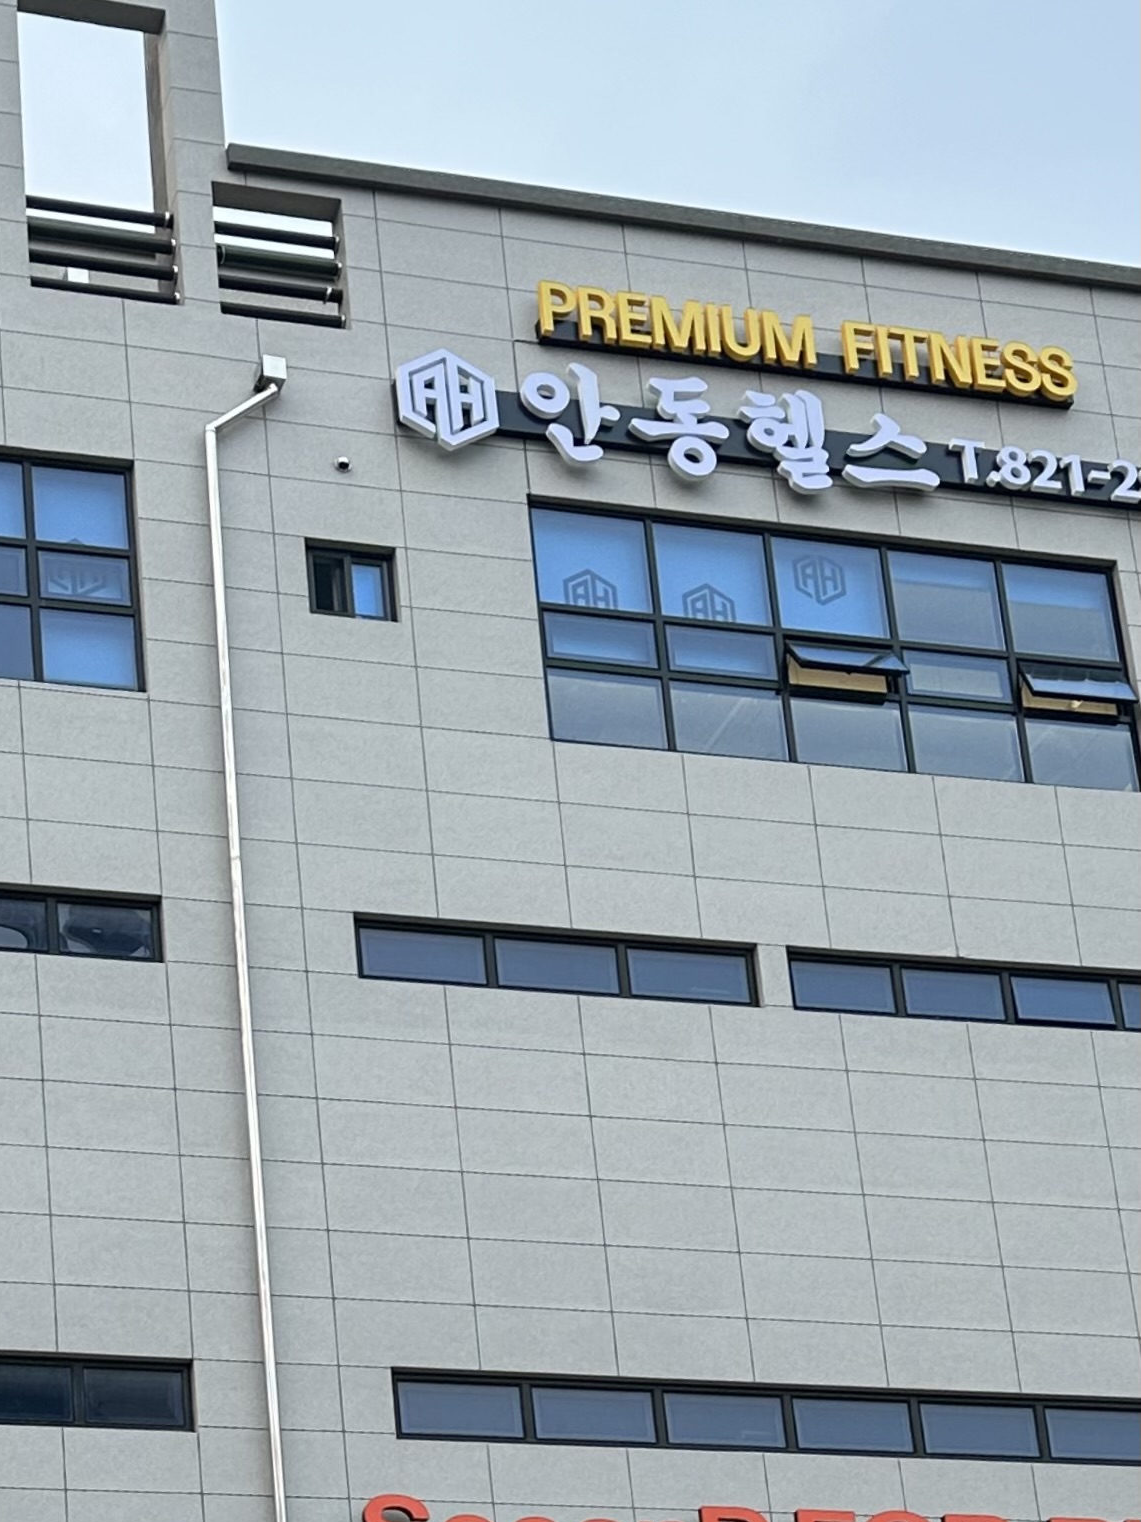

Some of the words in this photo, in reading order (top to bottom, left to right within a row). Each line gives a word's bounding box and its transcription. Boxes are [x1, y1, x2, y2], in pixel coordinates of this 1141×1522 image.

[538, 279, 817, 368] PREMIUM
[841, 320, 1078, 400] FITNESS
[520, 362, 940, 494] 안동헬스
[948, 438, 1141, 503] T.821-2
